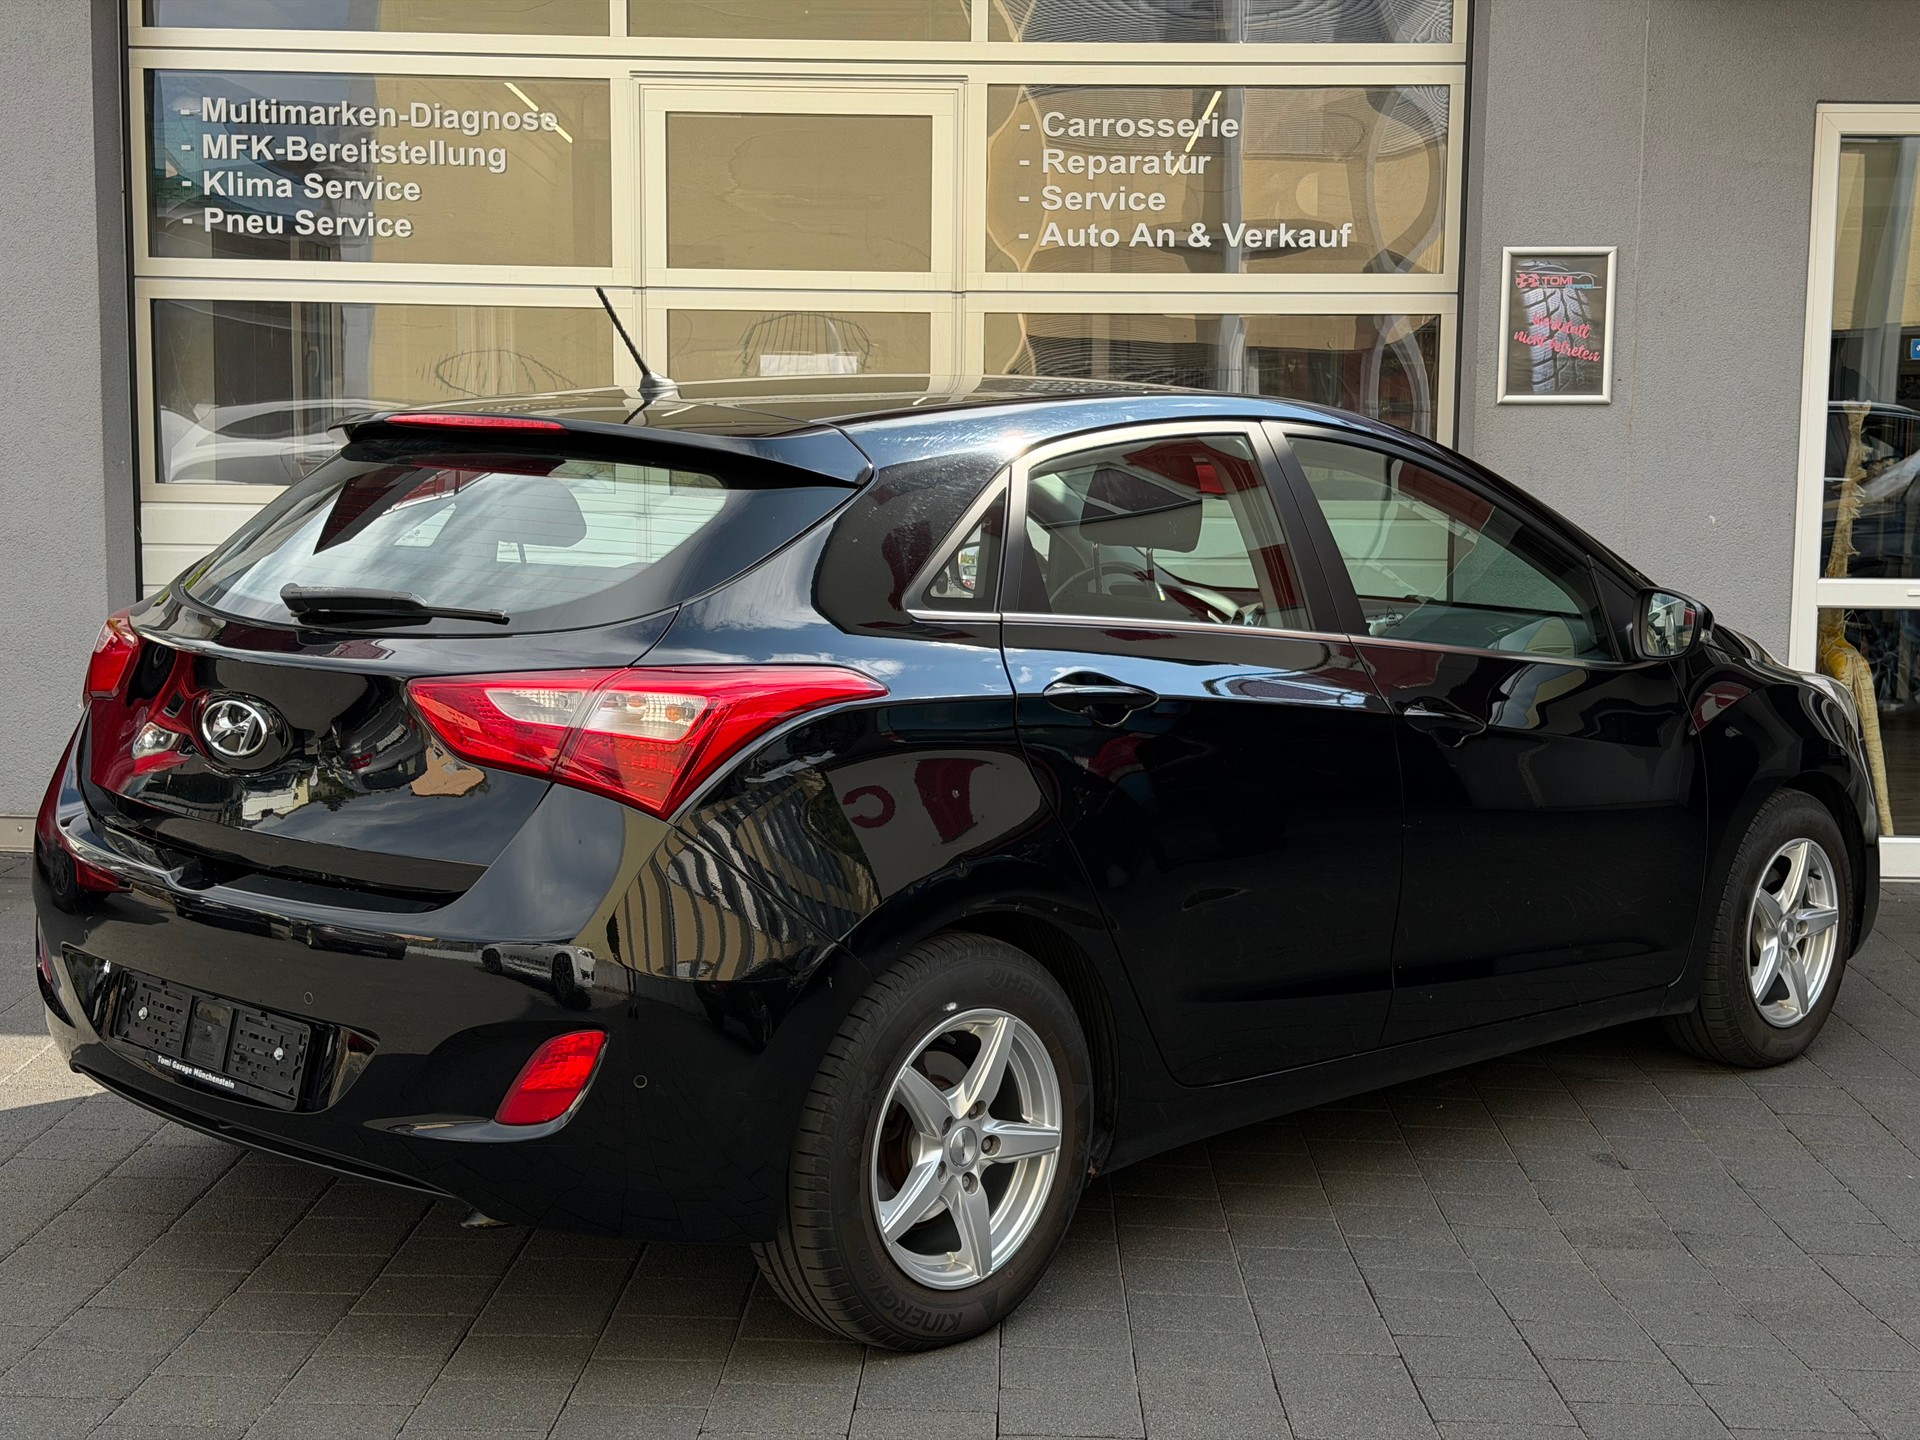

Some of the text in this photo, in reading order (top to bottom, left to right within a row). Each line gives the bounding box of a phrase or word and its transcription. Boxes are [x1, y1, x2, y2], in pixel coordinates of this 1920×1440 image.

[201, 97, 559, 136] Multimarken-Diagnose
[1042, 111, 1240, 139] Carrosserie
[202, 134, 507, 174] MFK-Bereitstellung
[1042, 149, 1211, 180] Reparatur
[203, 171, 293, 199] Klima
[303, 173, 422, 202] Service
[1041, 185, 1166, 212] Service
[204, 208, 284, 235] Pneu
[294, 209, 413, 238] Service
[1040, 222, 1120, 249] Auto
[1130, 223, 1176, 248] An
[1187, 222, 1212, 249] &
[1223, 222, 1352, 249] Verkauf
[172, 1061, 193, 1075] Garage
